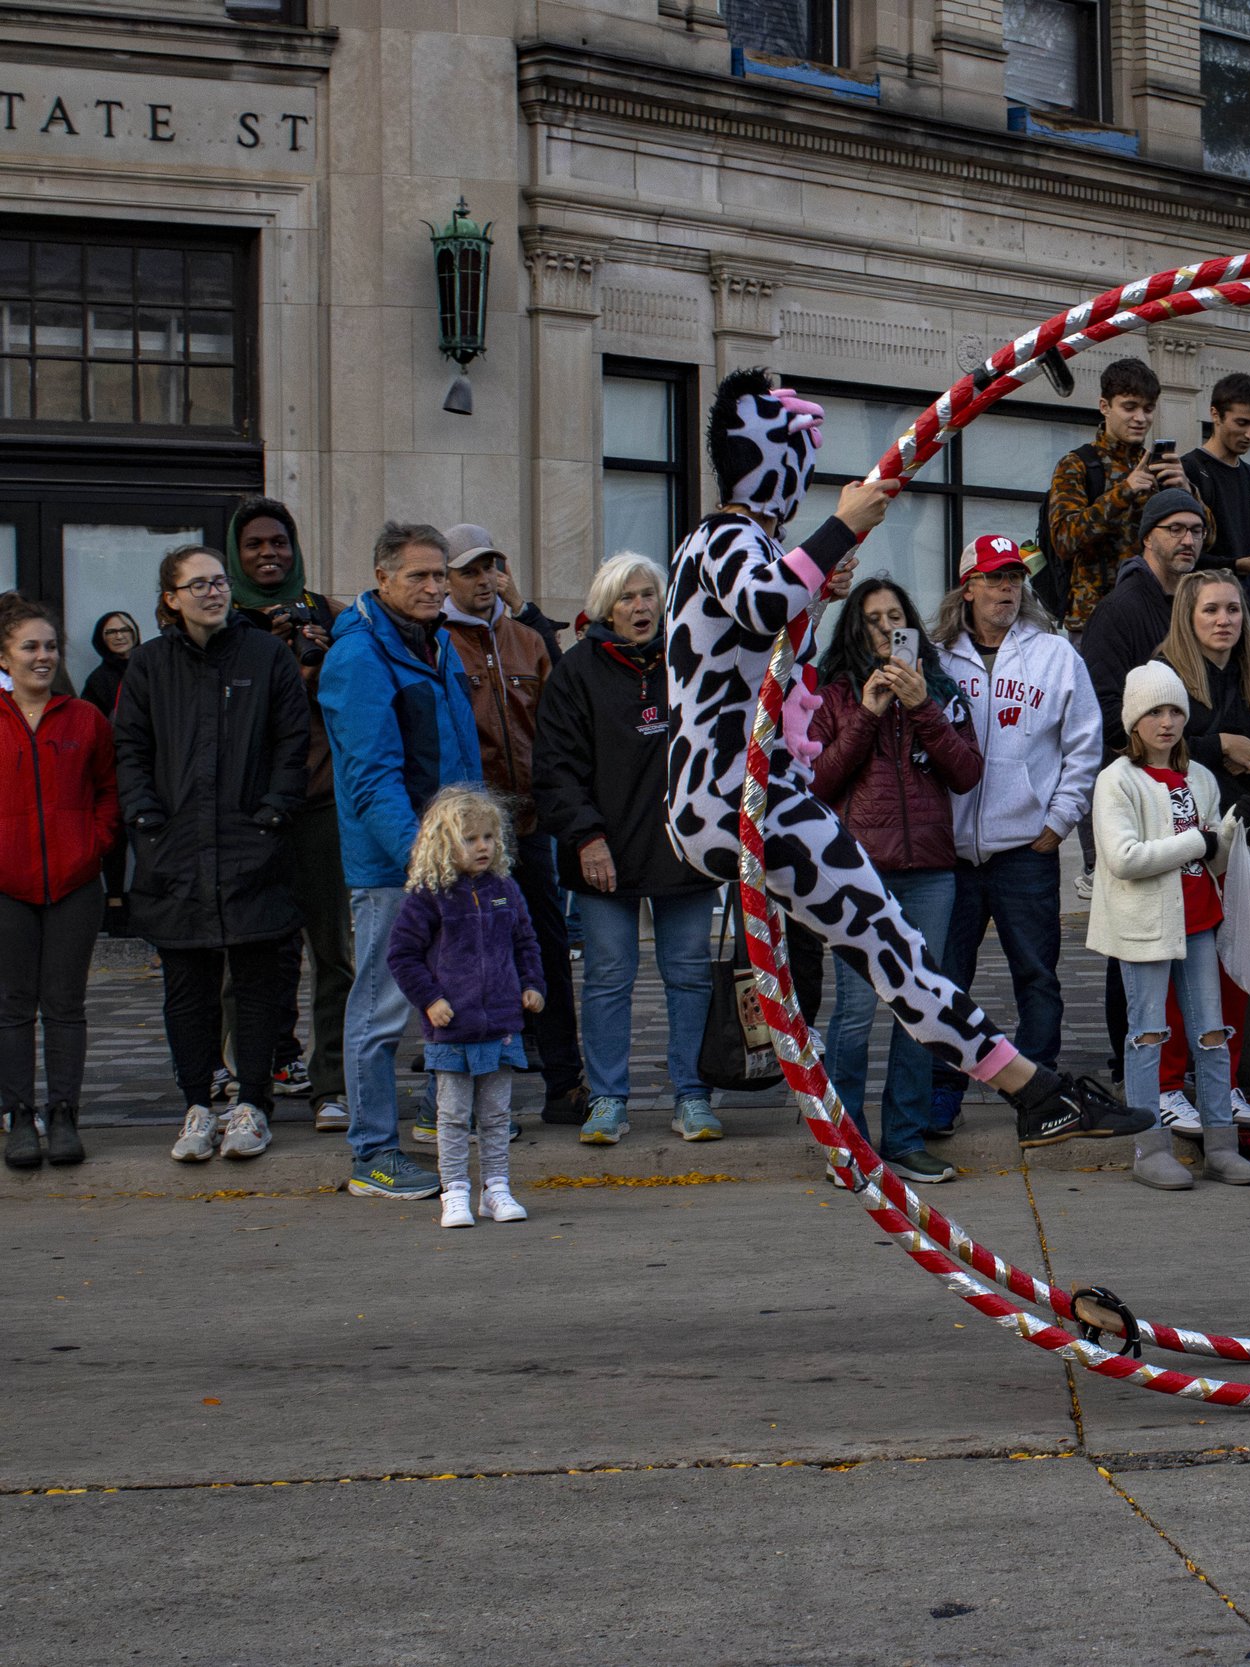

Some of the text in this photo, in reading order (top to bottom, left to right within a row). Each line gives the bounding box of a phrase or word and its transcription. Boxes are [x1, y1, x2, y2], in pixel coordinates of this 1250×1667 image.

[237, 111, 310, 151] ST
[990, 537, 1013, 553] W
[642, 707, 658, 723] W
[997, 706, 1022, 729] W
